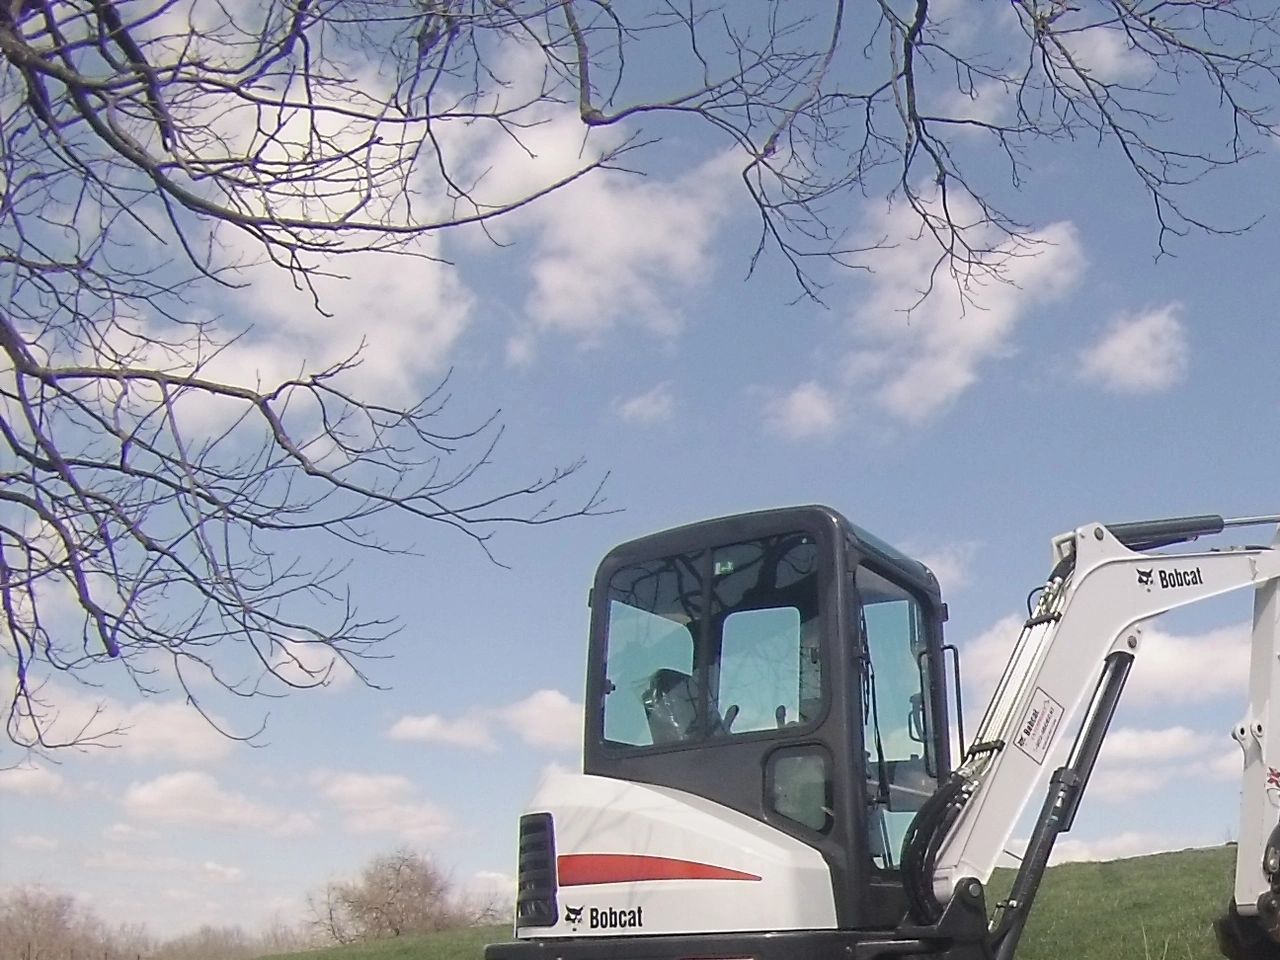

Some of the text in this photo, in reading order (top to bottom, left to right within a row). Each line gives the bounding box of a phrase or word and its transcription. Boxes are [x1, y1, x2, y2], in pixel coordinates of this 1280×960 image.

[1159, 567, 1203, 588] Bobcat
[1023, 708, 1040, 737] Bobcat
[590, 906, 643, 929] Bobcat
